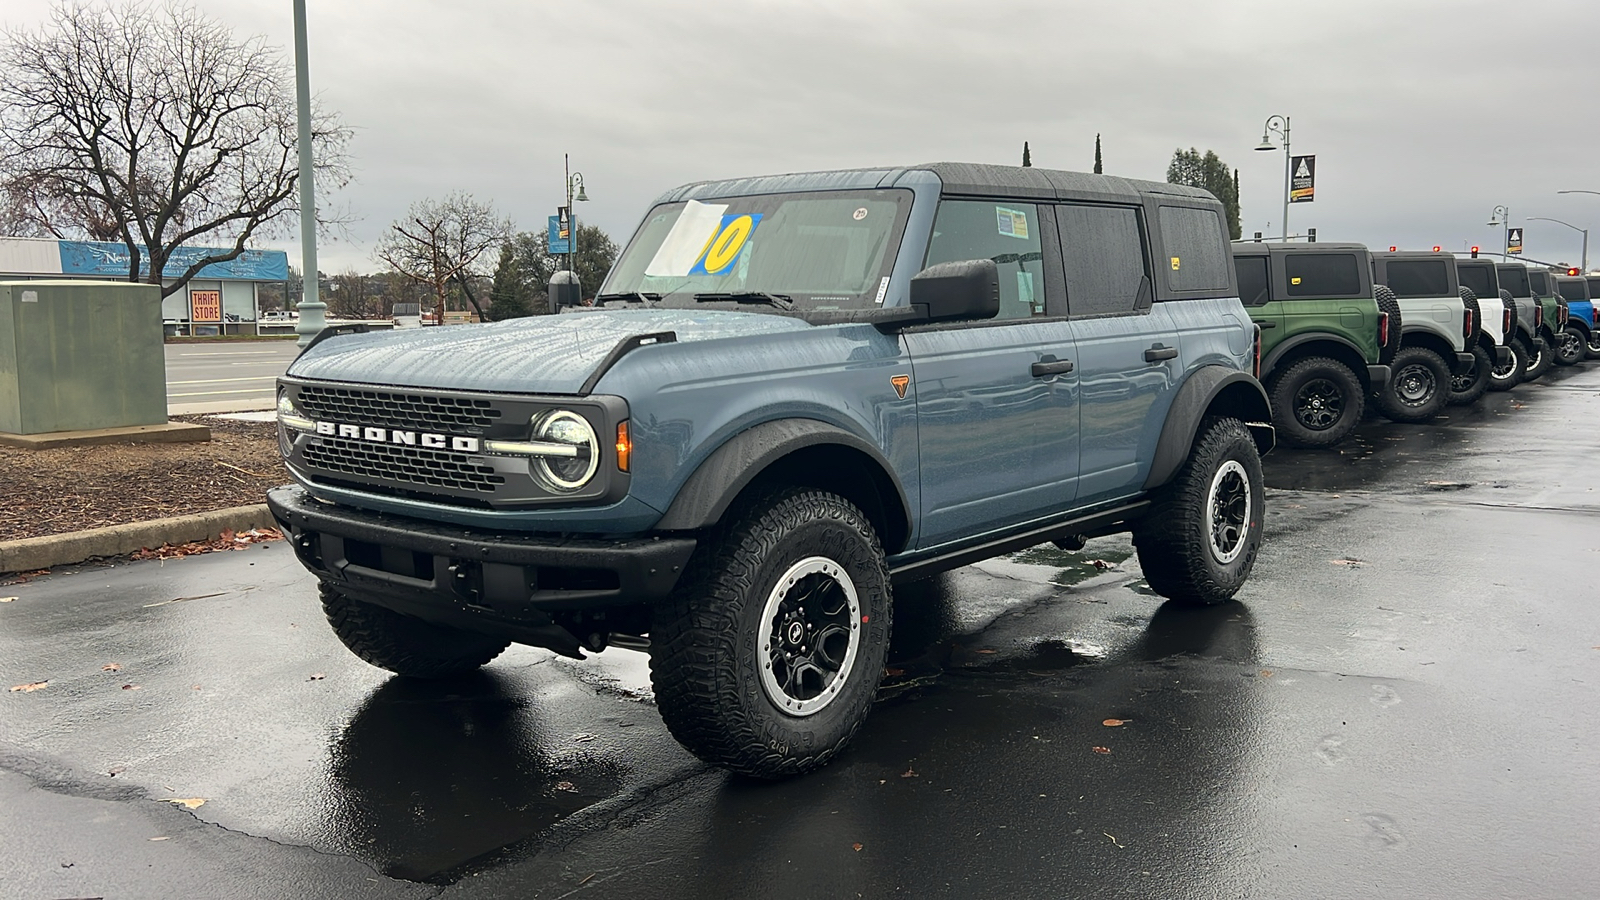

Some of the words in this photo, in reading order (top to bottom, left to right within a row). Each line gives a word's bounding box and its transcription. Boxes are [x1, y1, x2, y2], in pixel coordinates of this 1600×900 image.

[855, 209, 866, 218] 25
[193, 293, 218, 305] THRIFT
[195, 307, 219, 319] STORE
[316, 420, 480, 452] BRONCO
